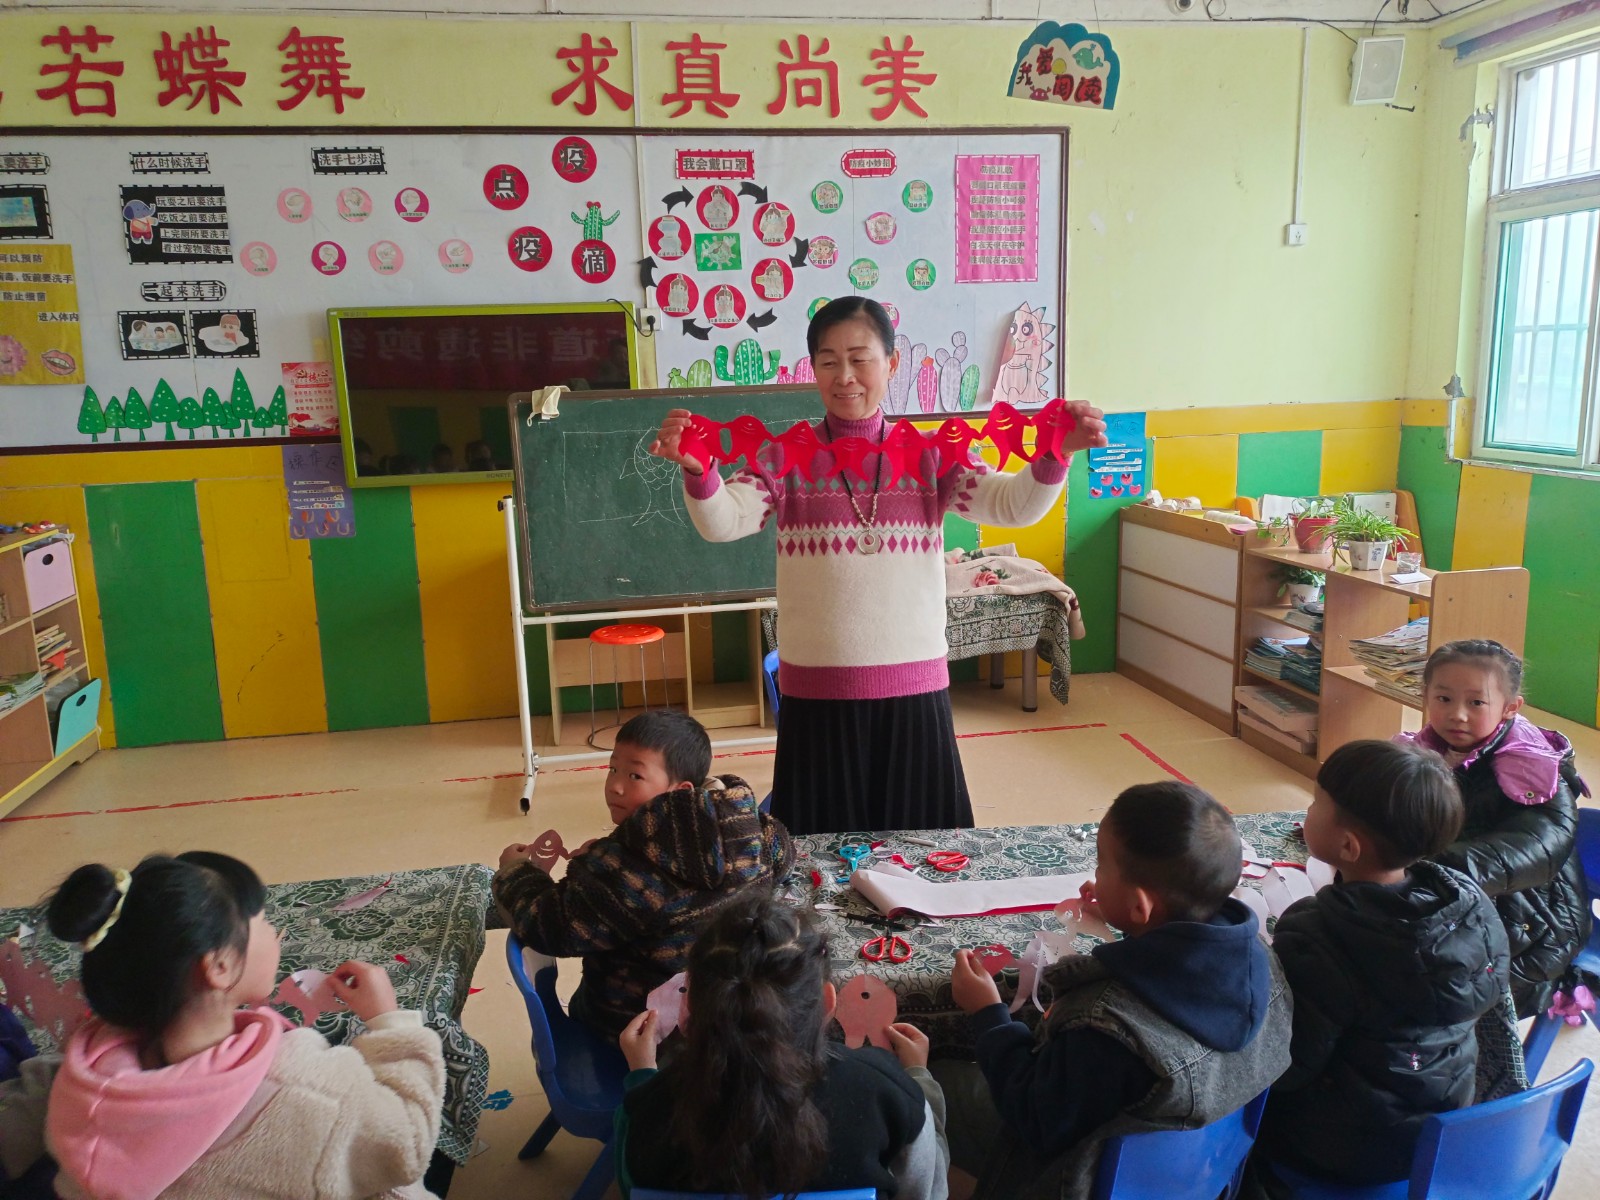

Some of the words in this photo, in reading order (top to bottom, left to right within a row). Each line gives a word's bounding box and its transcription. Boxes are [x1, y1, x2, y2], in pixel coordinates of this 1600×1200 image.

[36, 25, 366, 118] 若蝶舞
[551, 32, 938, 121] 求真尚美
[0, 156, 43, 168] 要洗手
[135, 156, 206, 169] 什么时候洗手
[319, 153, 381, 165] 洗手七步法
[559, 142, 590, 174] 疫
[682, 157, 748, 171] 我会戴口罩
[849, 158, 892, 168] 防疫小妙招
[491, 168, 520, 201] 点
[156, 196, 226, 207] 玩耍之后要洗手
[159, 213, 227, 223] 吃饭之前要洗手
[161, 229, 228, 240] 上完厕所要洗手
[163, 243, 231, 255] 看过宠物要洗手
[513, 231, 544, 263] 疫
[581, 245, 609, 275] 滴
[144, 285, 221, 297] 一起来洗手
[38, 312, 79, 322] 进入体内
